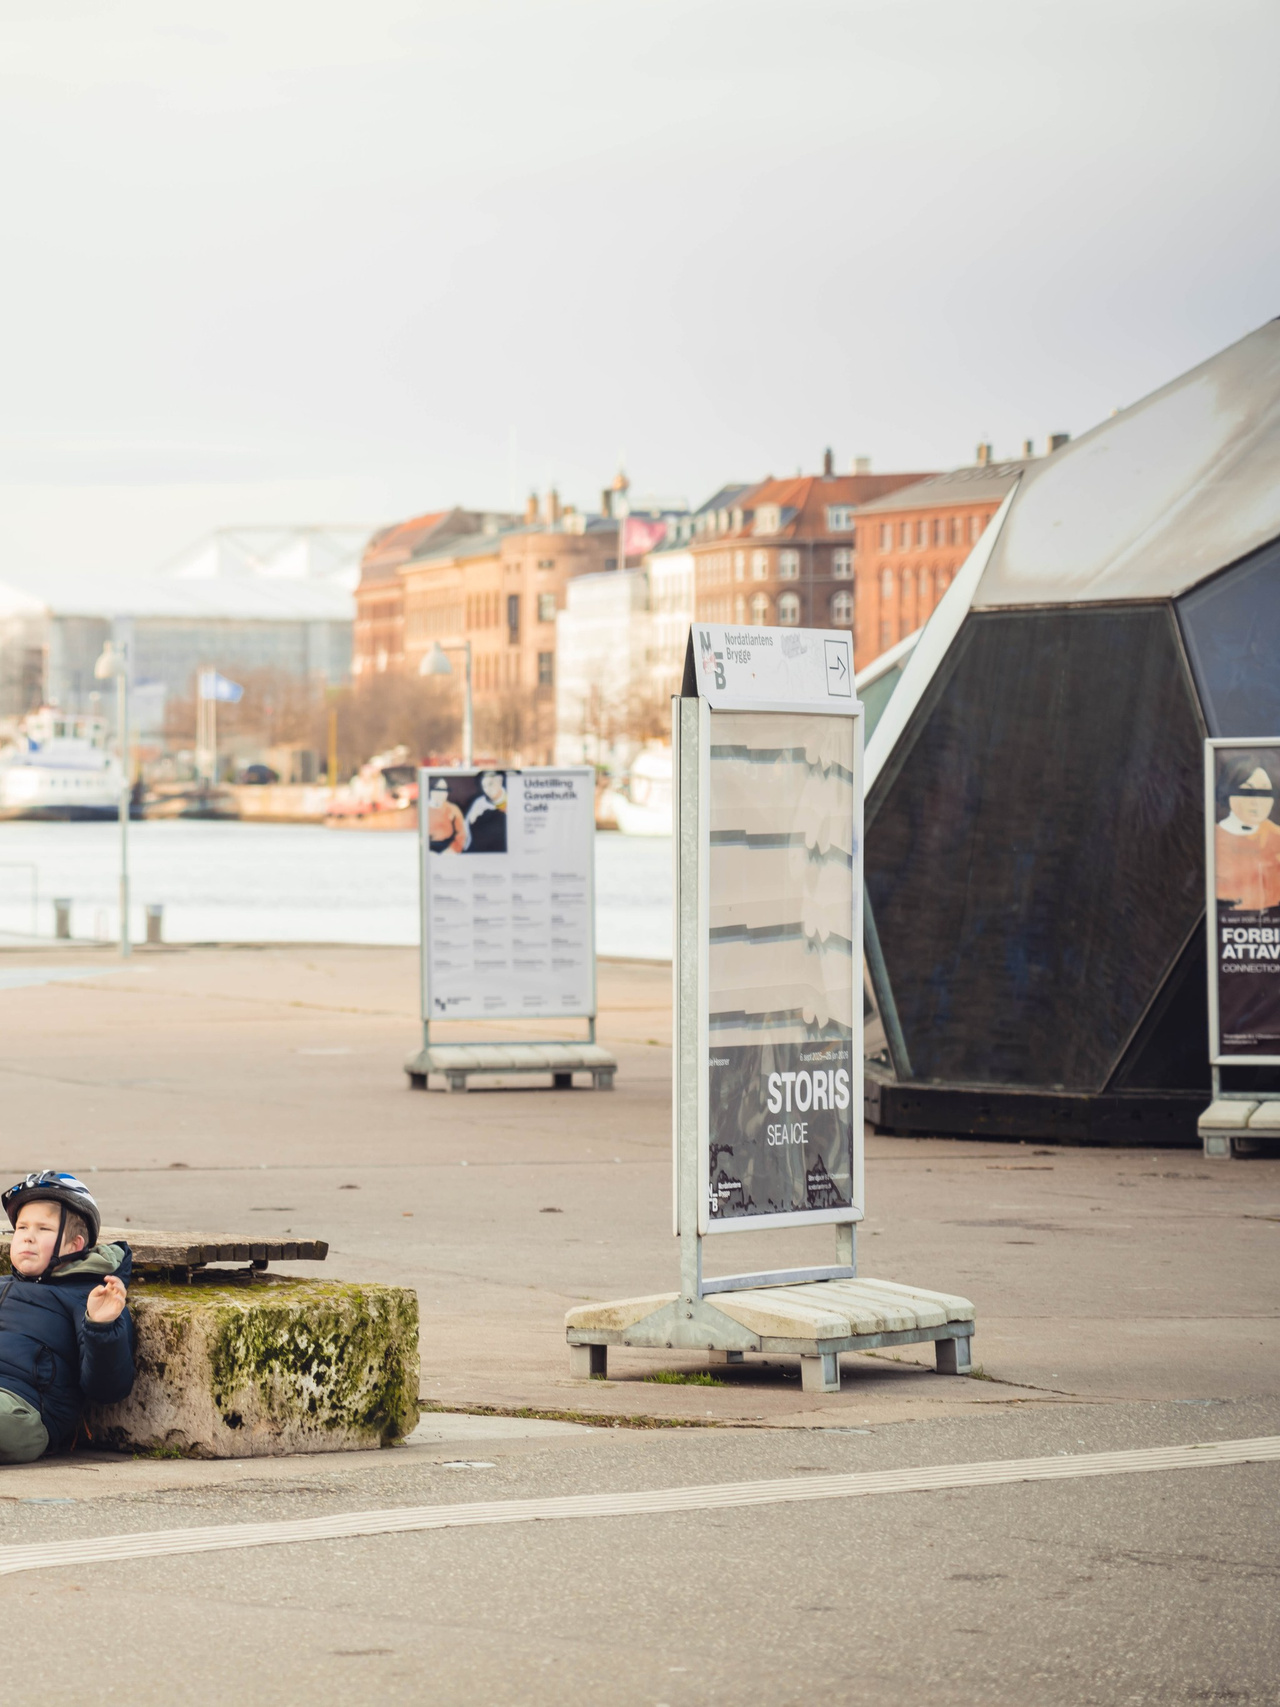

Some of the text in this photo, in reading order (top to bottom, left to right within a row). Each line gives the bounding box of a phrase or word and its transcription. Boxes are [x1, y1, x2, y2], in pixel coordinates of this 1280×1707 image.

[725, 632, 773, 646] Nordatlantens
[726, 647, 751, 664] Brygge
[524, 803, 549, 813] Café
[1222, 927, 1280, 943] FORBI
[1222, 944, 1280, 960] ATTAV
[767, 1068, 850, 1114] STORIS
[767, 1122, 808, 1146] SEA ICE
